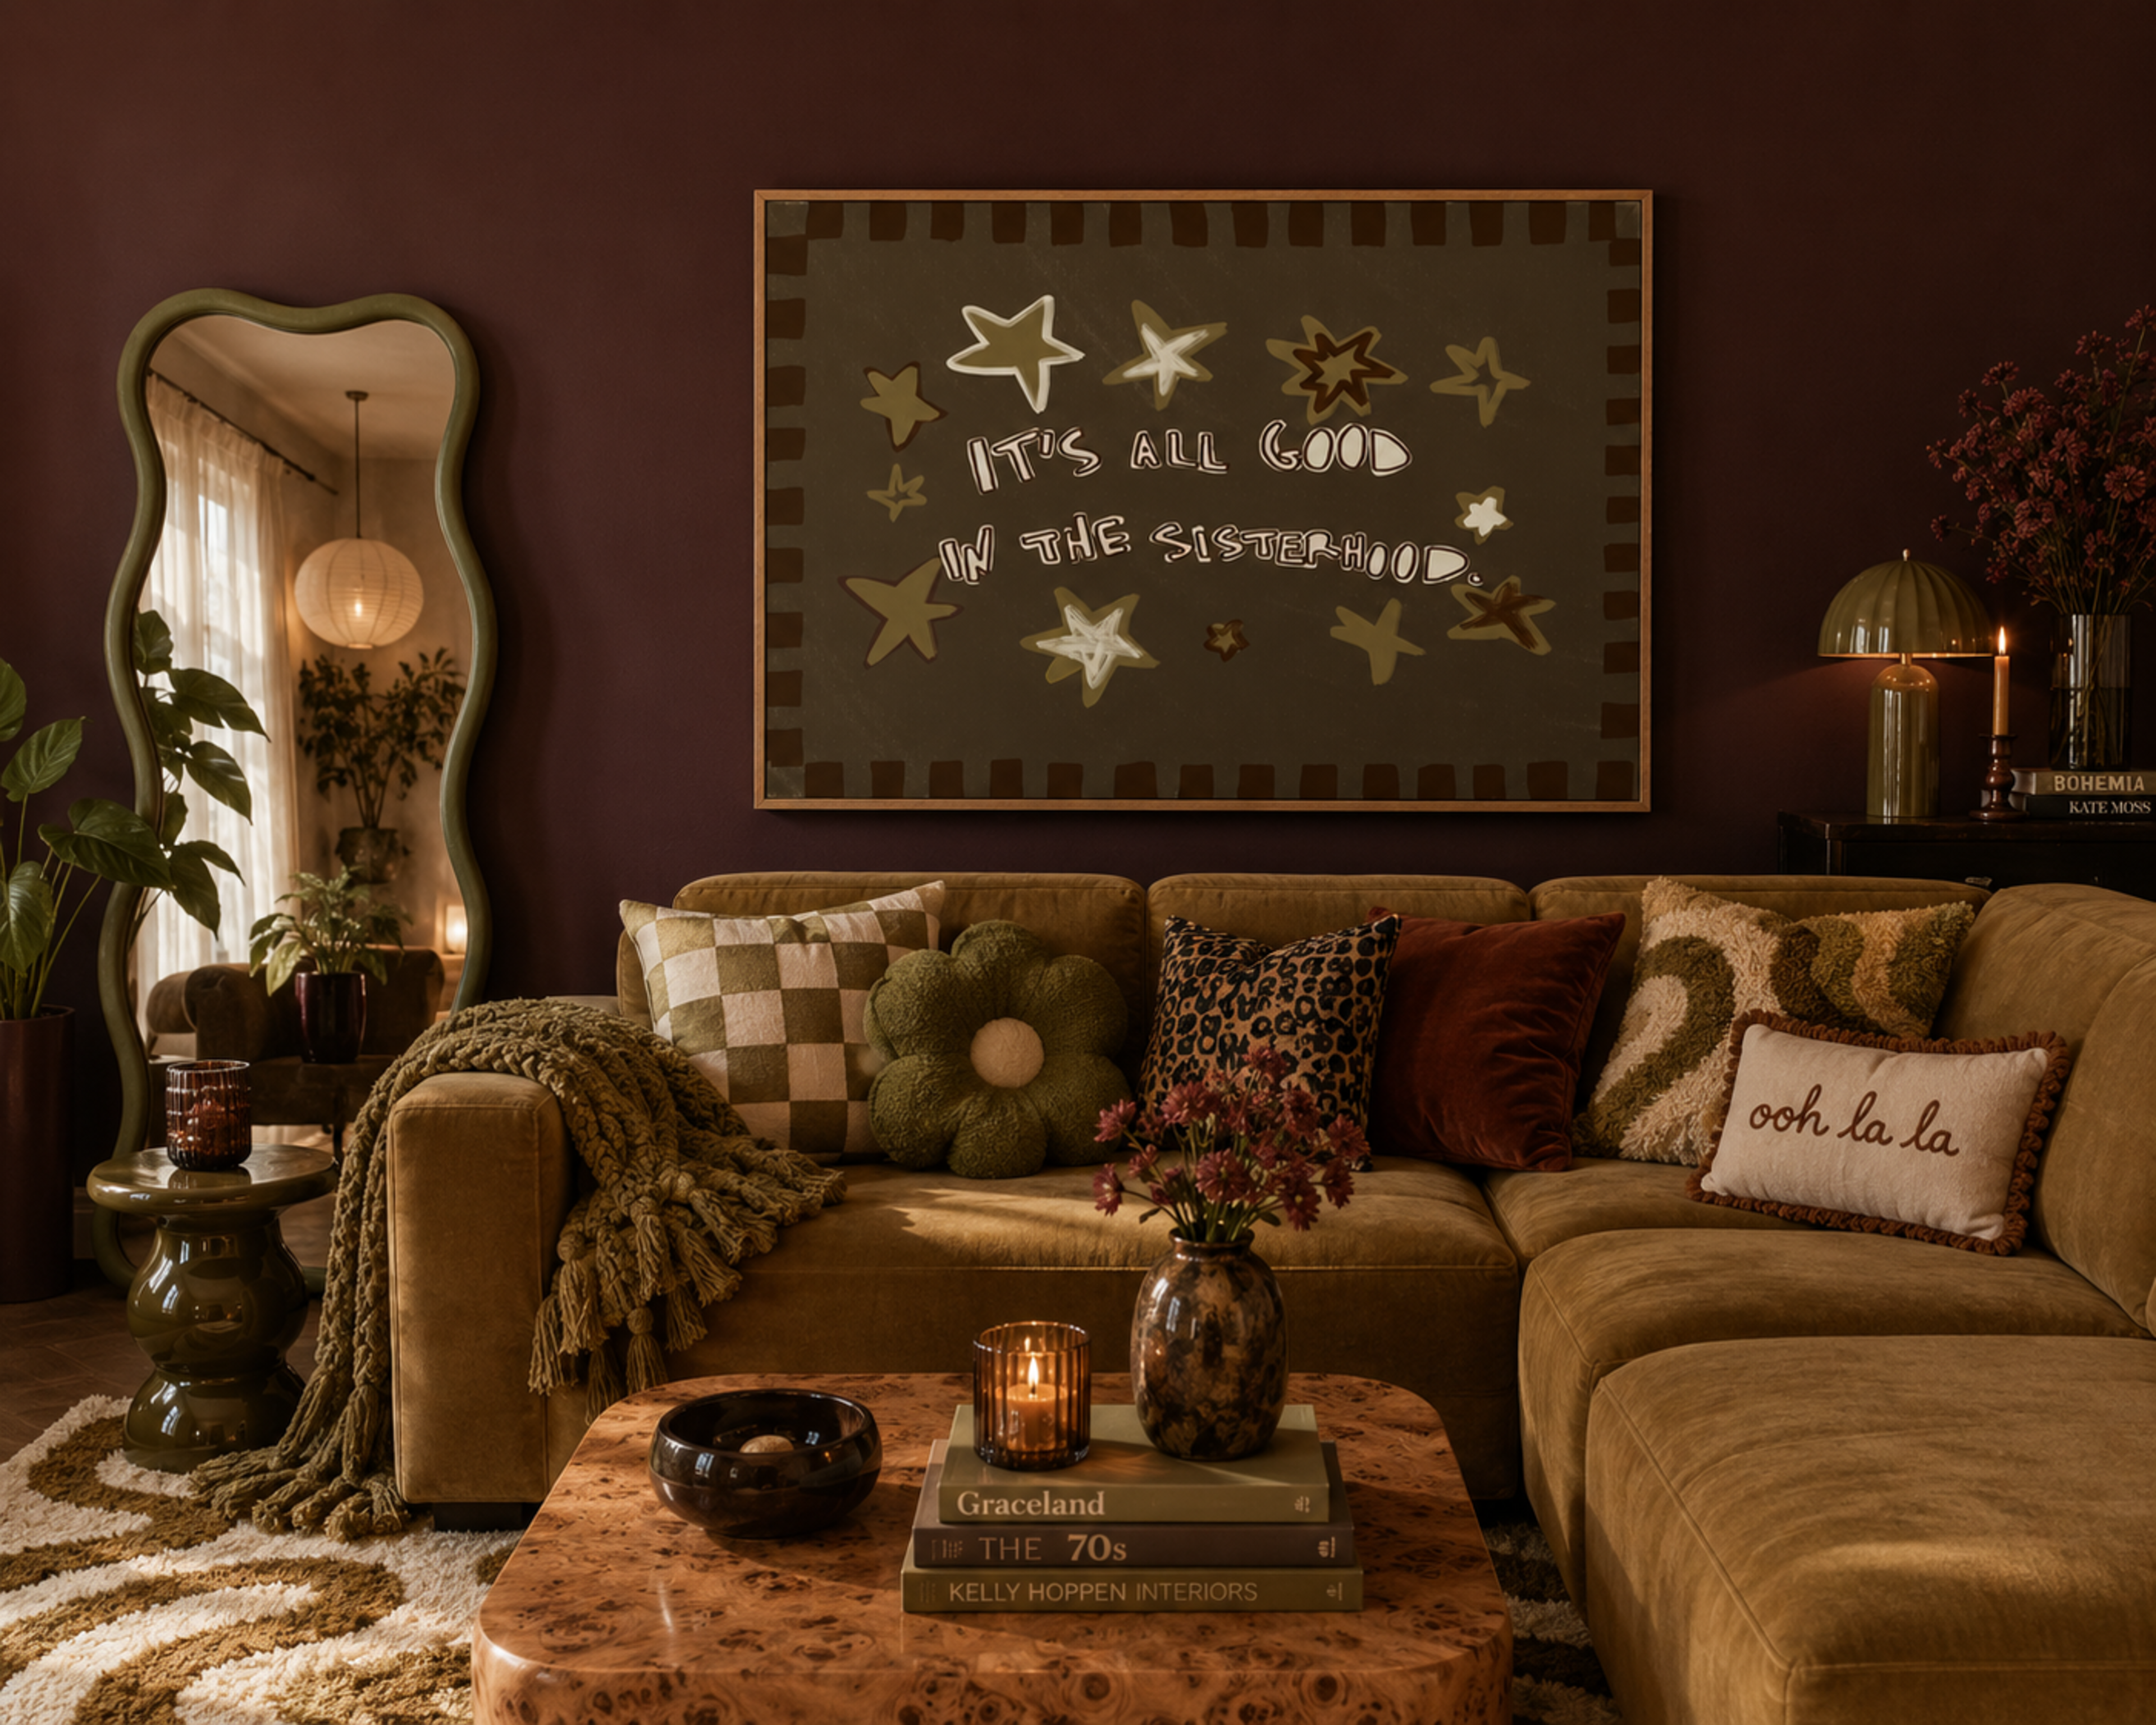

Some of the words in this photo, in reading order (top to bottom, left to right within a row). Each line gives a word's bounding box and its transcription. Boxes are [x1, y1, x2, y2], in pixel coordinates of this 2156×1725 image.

[967, 428, 1103, 495] IT'S
[1130, 429, 1230, 474] ALL
[1259, 419, 1413, 477] GOOD
[938, 525, 995, 584] IN
[1019, 512, 1131, 565] THE
[1149, 522, 1484, 585] SISTERHOOD.
[2054, 775, 2145, 791] BOHEMIA
[2069, 800, 2108, 814] KATE
[2111, 800, 2152, 814] MOSS
[1750, 1084, 1829, 1136] ooh
[1837, 1091, 1893, 1145] la
[1900, 1100, 1959, 1156] la
[957, 1490, 1106, 1516] Graceland
[979, 1538, 1042, 1561] THE
[1067, 1534, 1127, 1562] 70s
[949, 1583, 1021, 1602] KELLY
[1029, 1583, 1125, 1602] HOPPEN
[1136, 1582, 1258, 1602] INTERIORS
